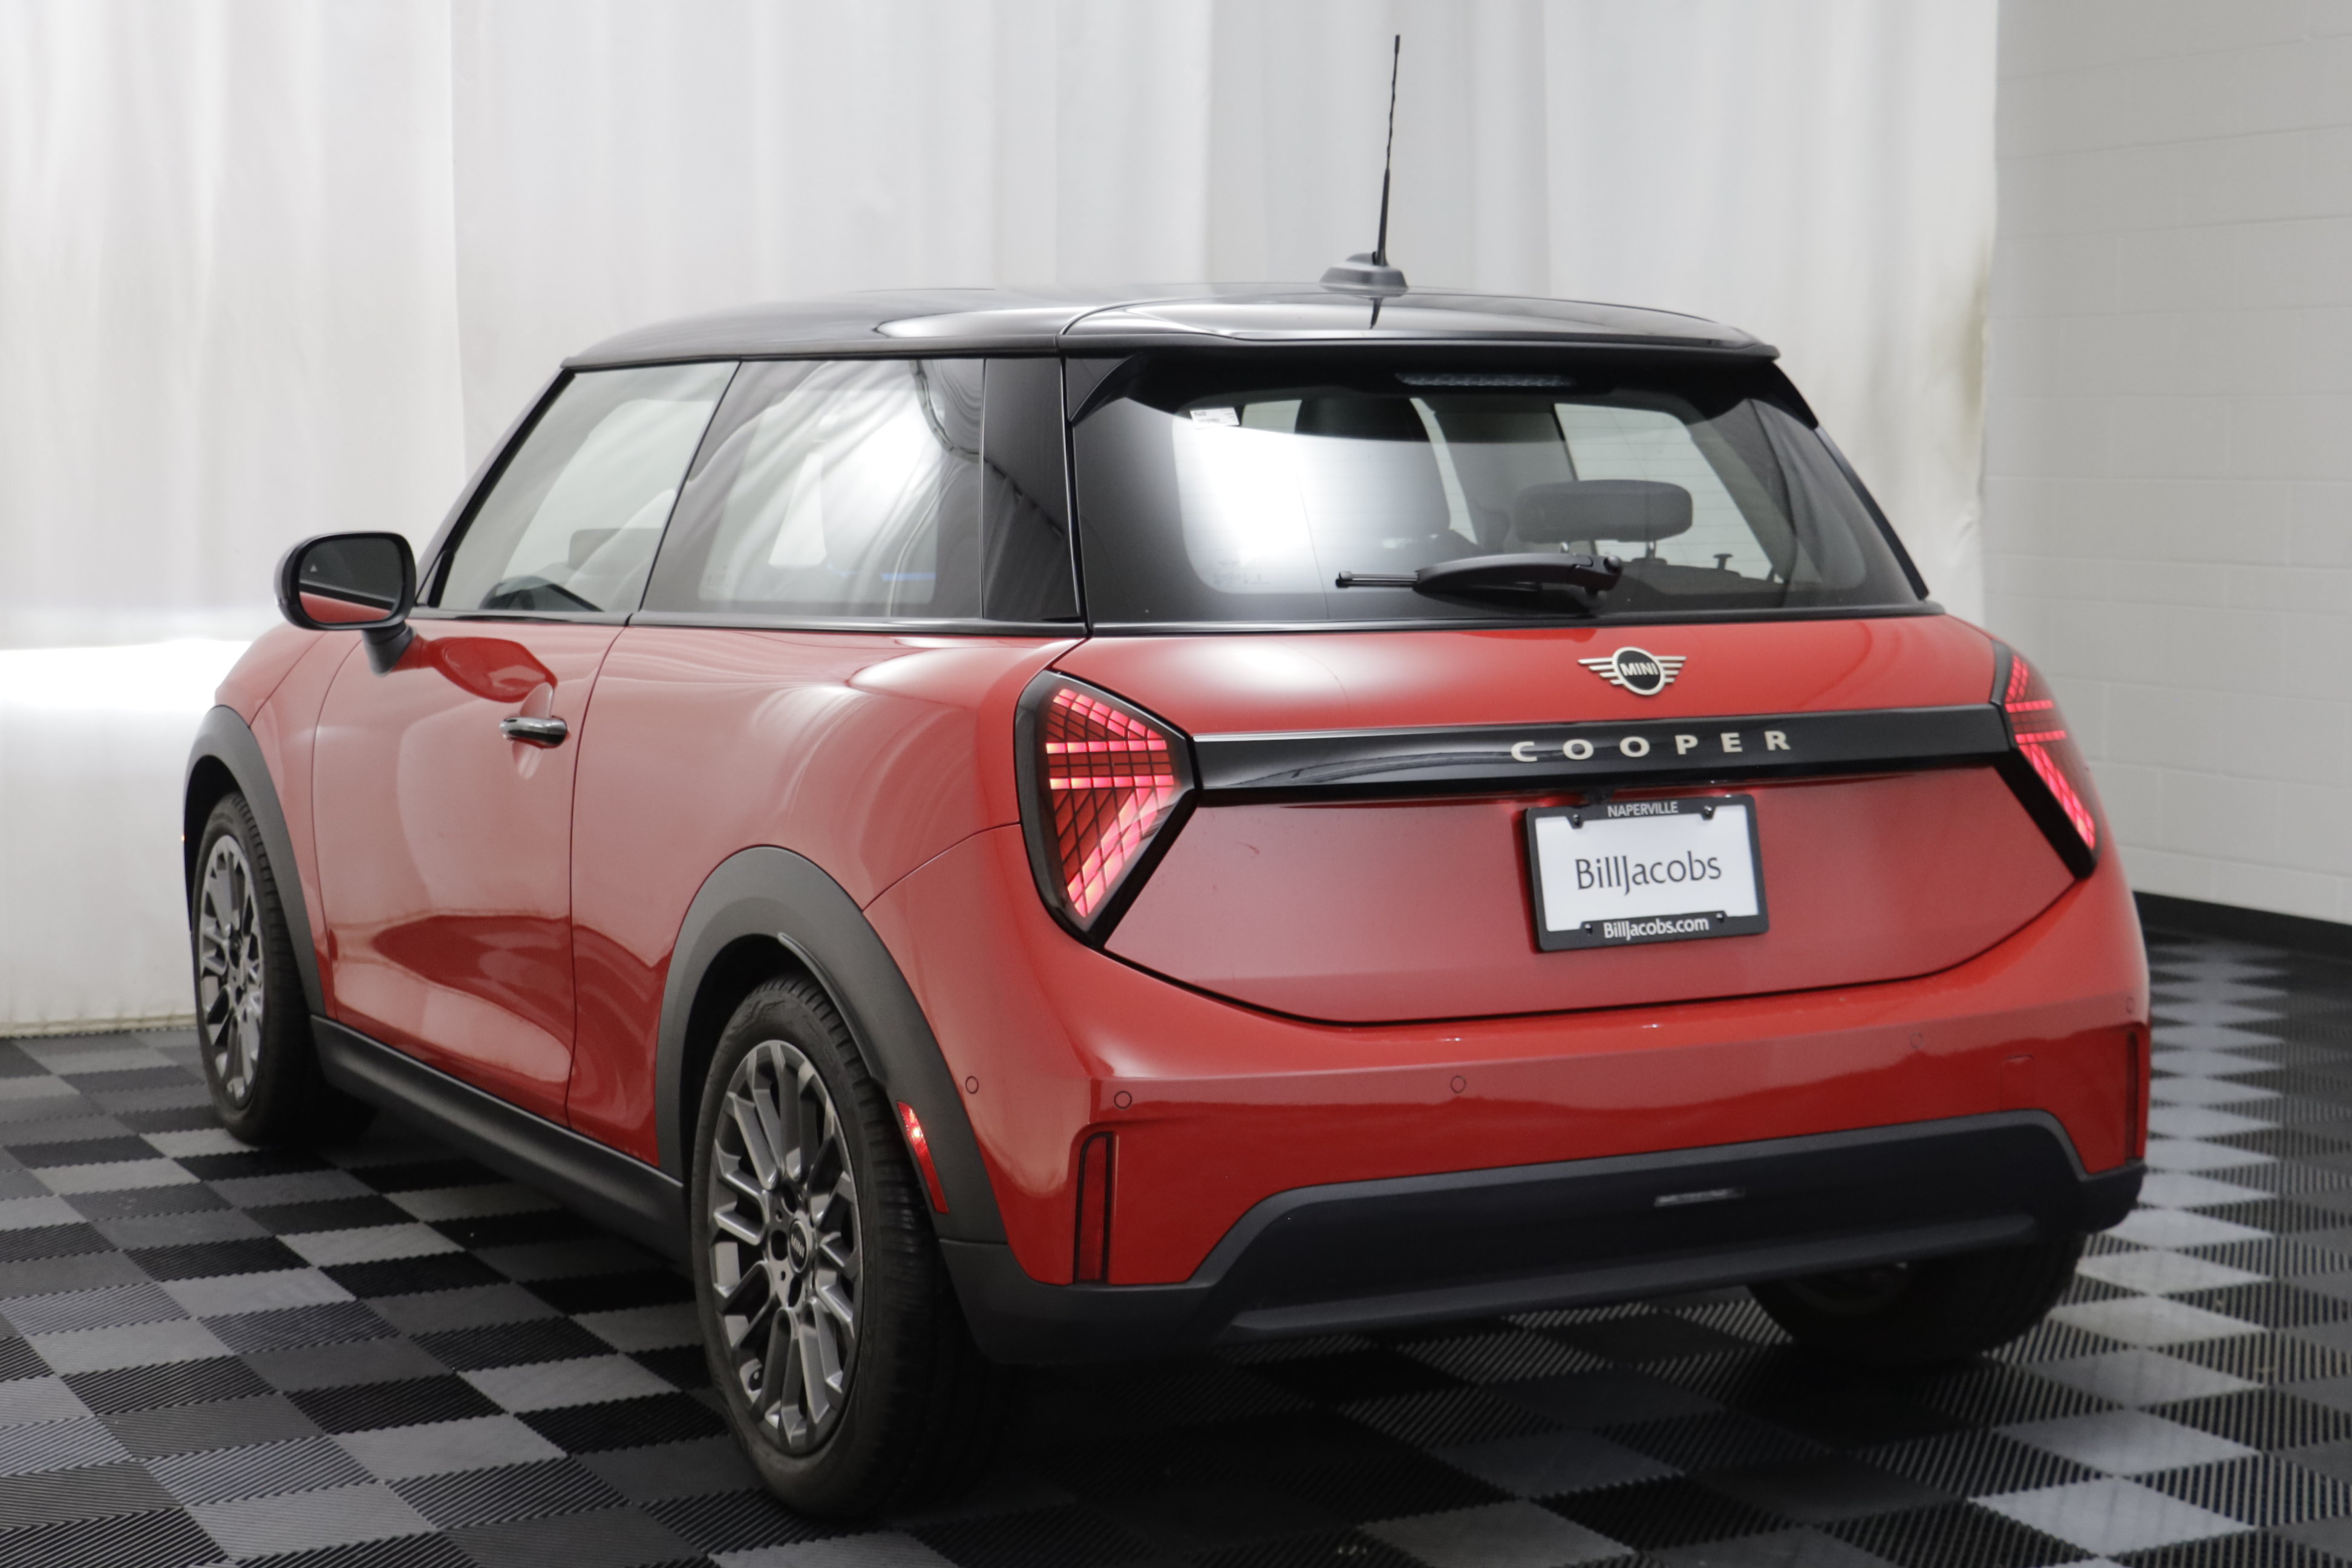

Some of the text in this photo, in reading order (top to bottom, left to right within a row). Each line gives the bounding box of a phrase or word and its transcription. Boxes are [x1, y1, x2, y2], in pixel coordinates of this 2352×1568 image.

[1620, 662, 1659, 676] MINI
[1511, 730, 1791, 762] COOPER
[1607, 801, 1679, 817] NAPERVILLE
[1575, 850, 1722, 896] BillJacobs
[1604, 918, 1709, 941] BillJacobs.com
